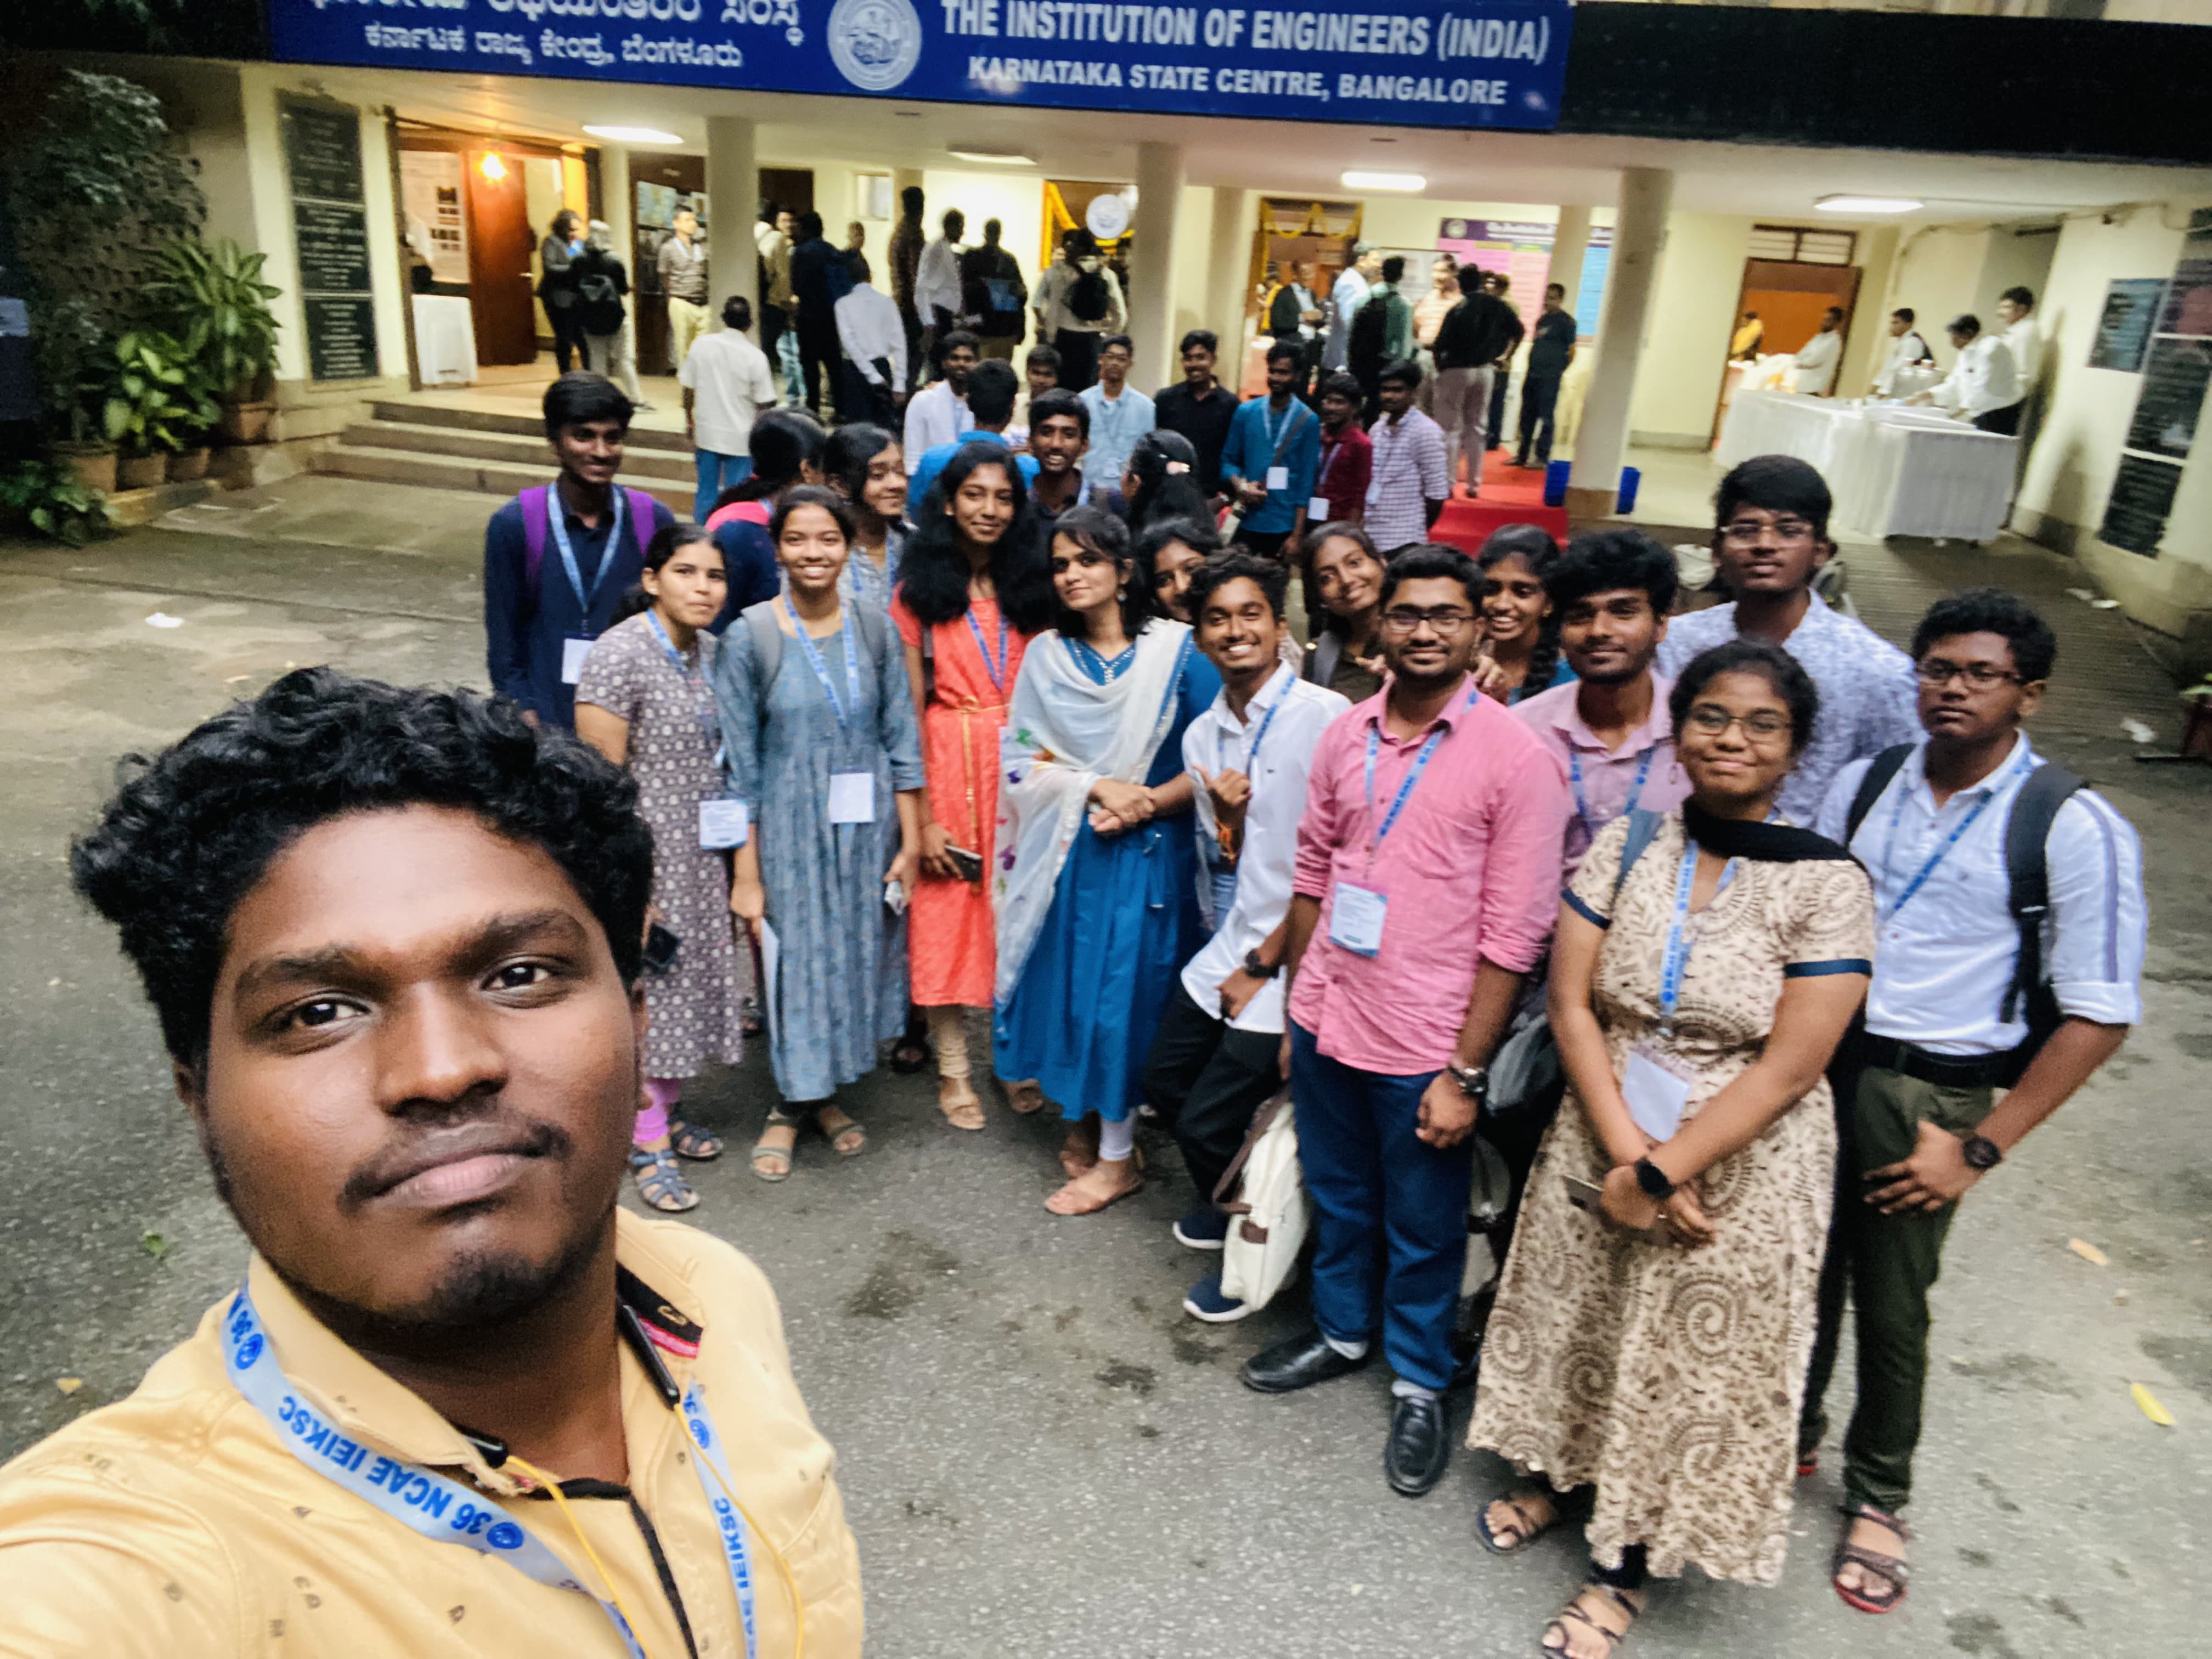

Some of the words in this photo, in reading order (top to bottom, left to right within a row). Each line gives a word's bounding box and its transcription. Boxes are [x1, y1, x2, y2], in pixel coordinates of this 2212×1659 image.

[941, 0, 998, 37] THE
[1006, 0, 1197, 46] INSTITUTION
[1204, 8, 1245, 48] OF
[1251, 10, 1431, 55] ENGINEERS
[1437, 12, 1549, 65] (INDIA)
[968, 56, 1122, 87] KARNATAKA
[1128, 64, 1210, 91] STATE
[1215, 68, 1330, 102] CENTRE,
[1337, 74, 1508, 105] BANGALORE
[278, 1396, 368, 1472] IEIKSC
[365, 1456, 453, 1519] NCAE
[450, 1503, 492, 1534] 36
[713, 1497, 749, 1589] IEIKSC
